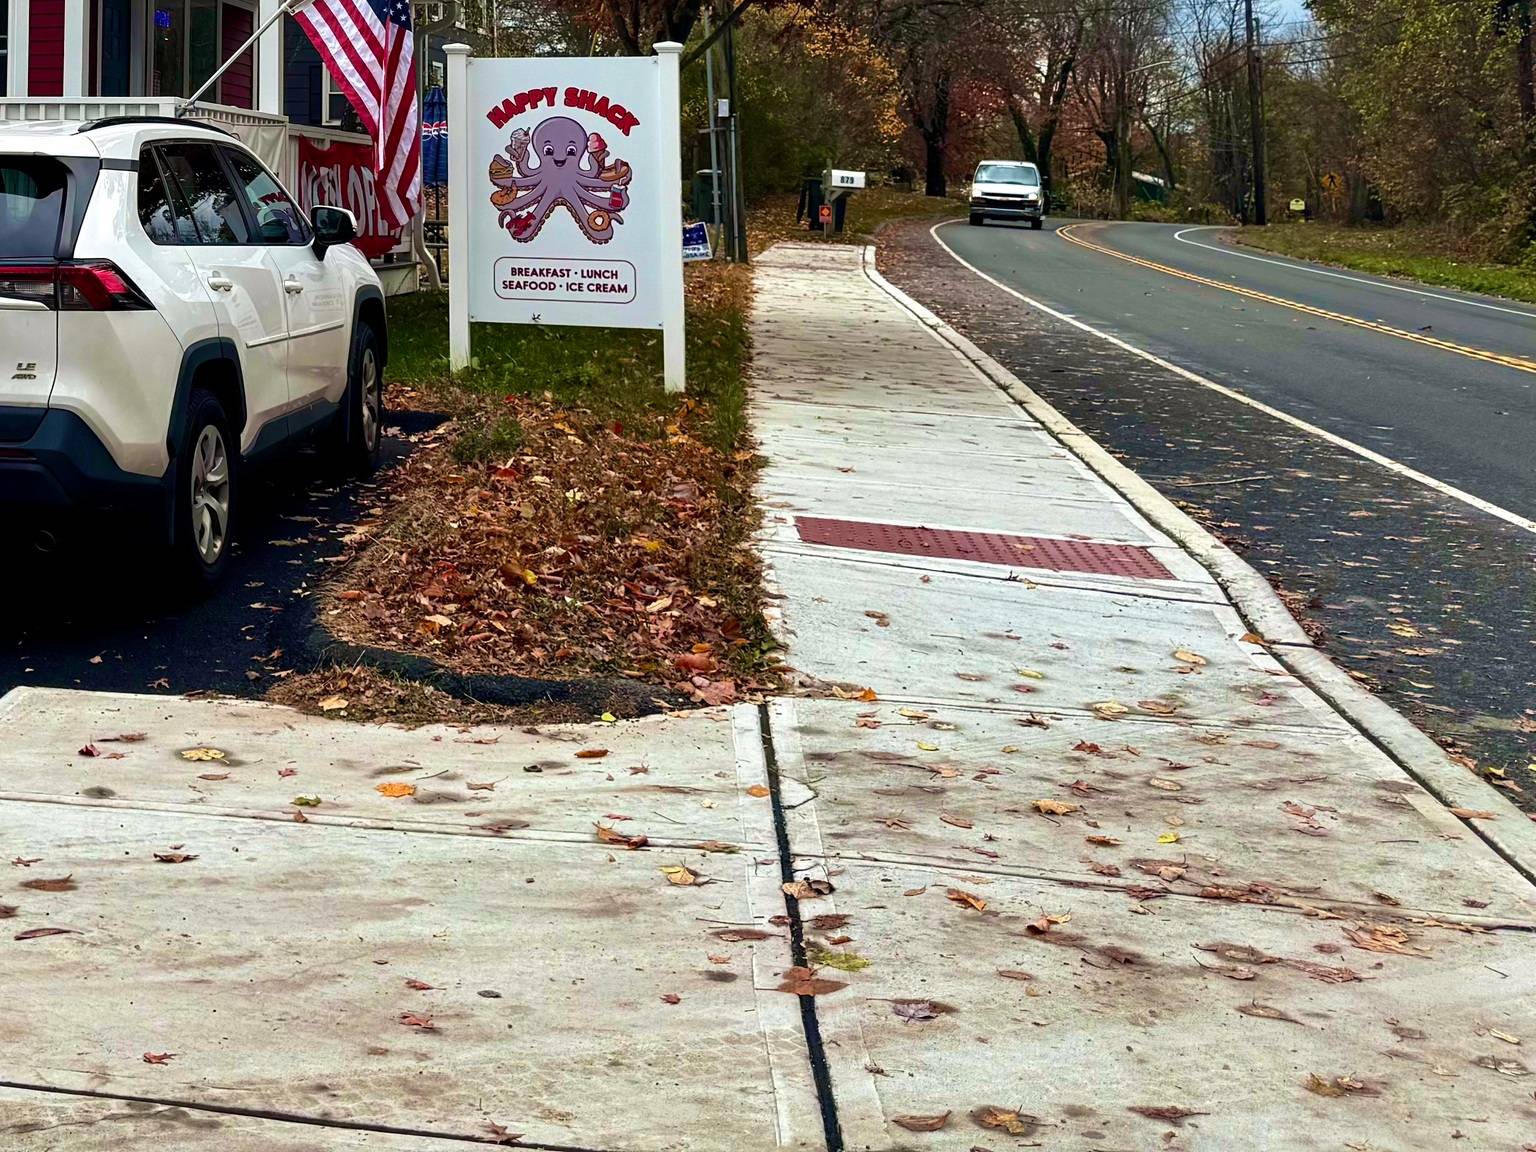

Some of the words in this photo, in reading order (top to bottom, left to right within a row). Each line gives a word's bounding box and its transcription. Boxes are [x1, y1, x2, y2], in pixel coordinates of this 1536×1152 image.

[486, 86, 558, 129] HAPPY
[564, 86, 640, 136] SHACK
[510, 267, 572, 278] BREAKFAST
[580, 269, 619, 280] LUNCH
[502, 280, 557, 291] SEAFOOD
[566, 282, 584, 292] ICE
[586, 283, 628, 294] CREAM
[16, 362, 37, 371] LE
